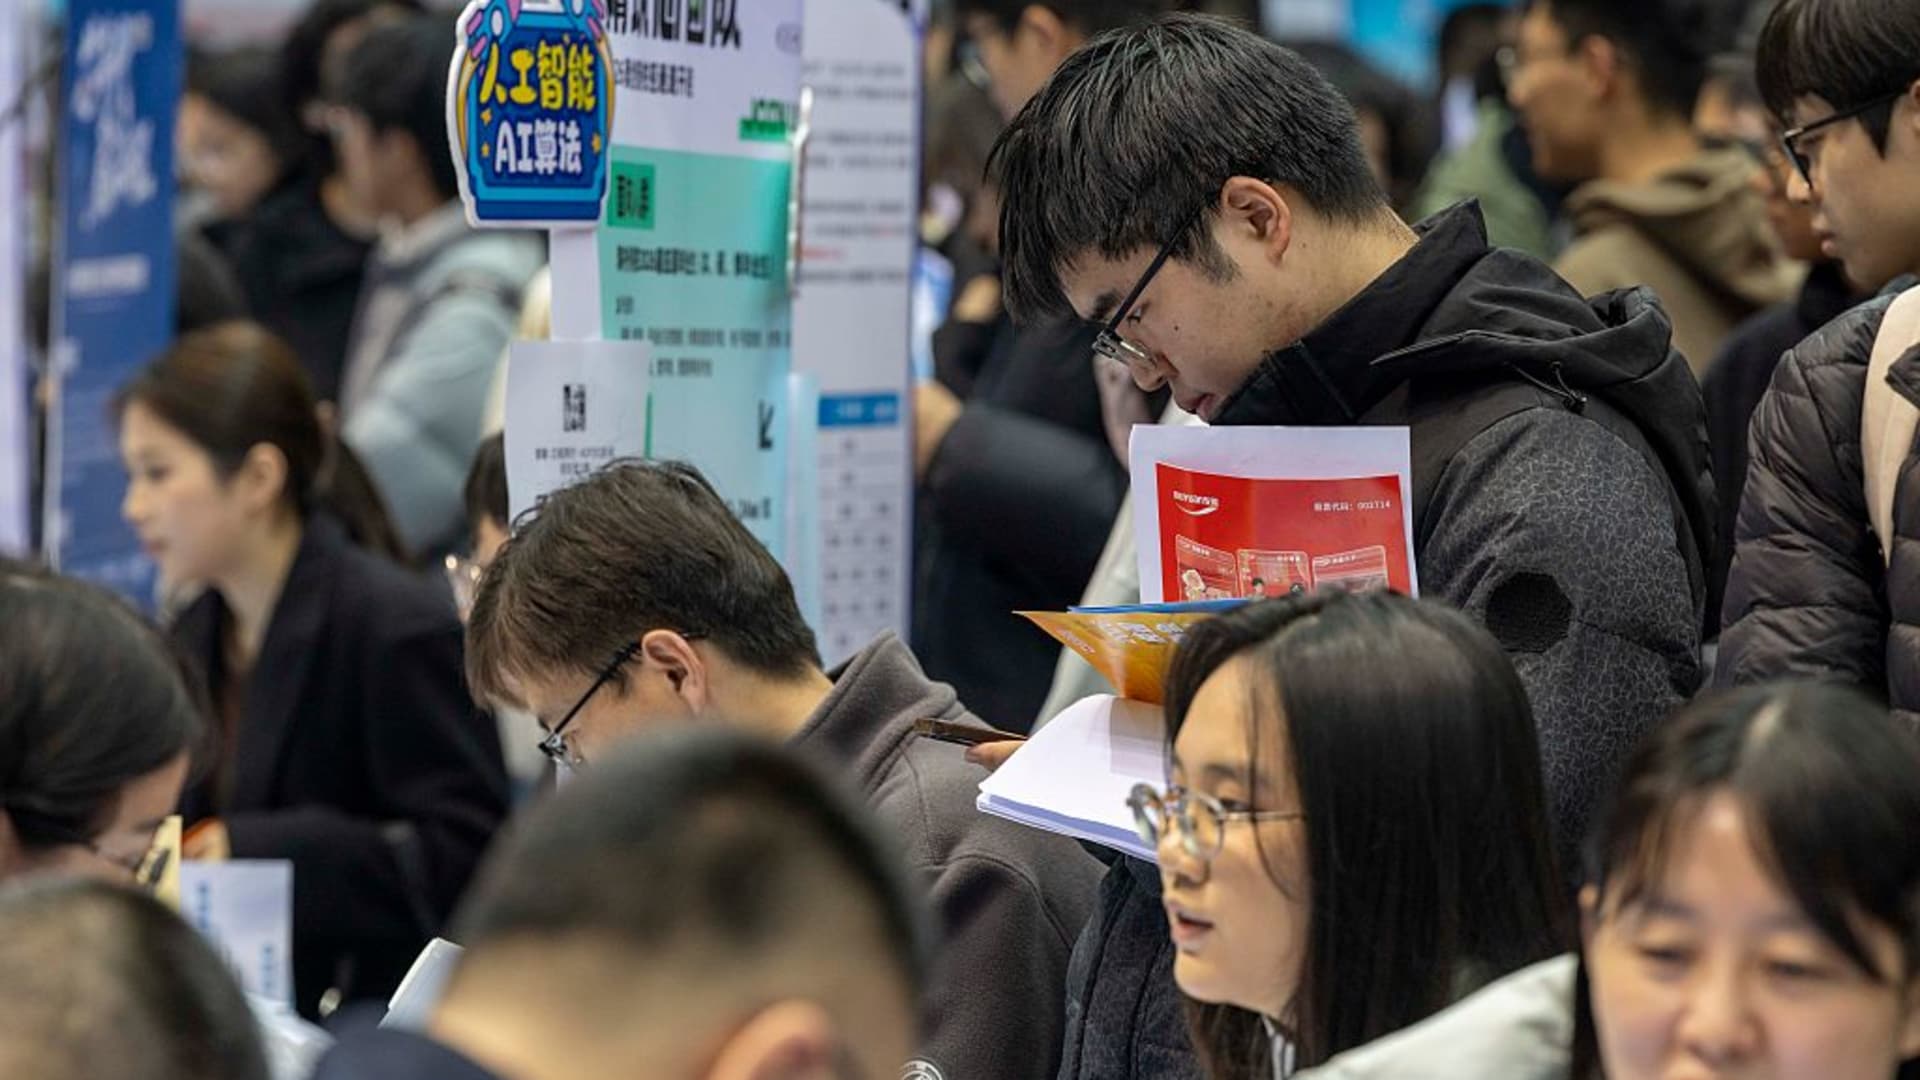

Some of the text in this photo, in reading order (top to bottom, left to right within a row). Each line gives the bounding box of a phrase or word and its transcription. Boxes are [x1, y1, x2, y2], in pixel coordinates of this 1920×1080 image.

[479, 39, 596, 112] 人工智能
[494, 118, 582, 175] AI算法
